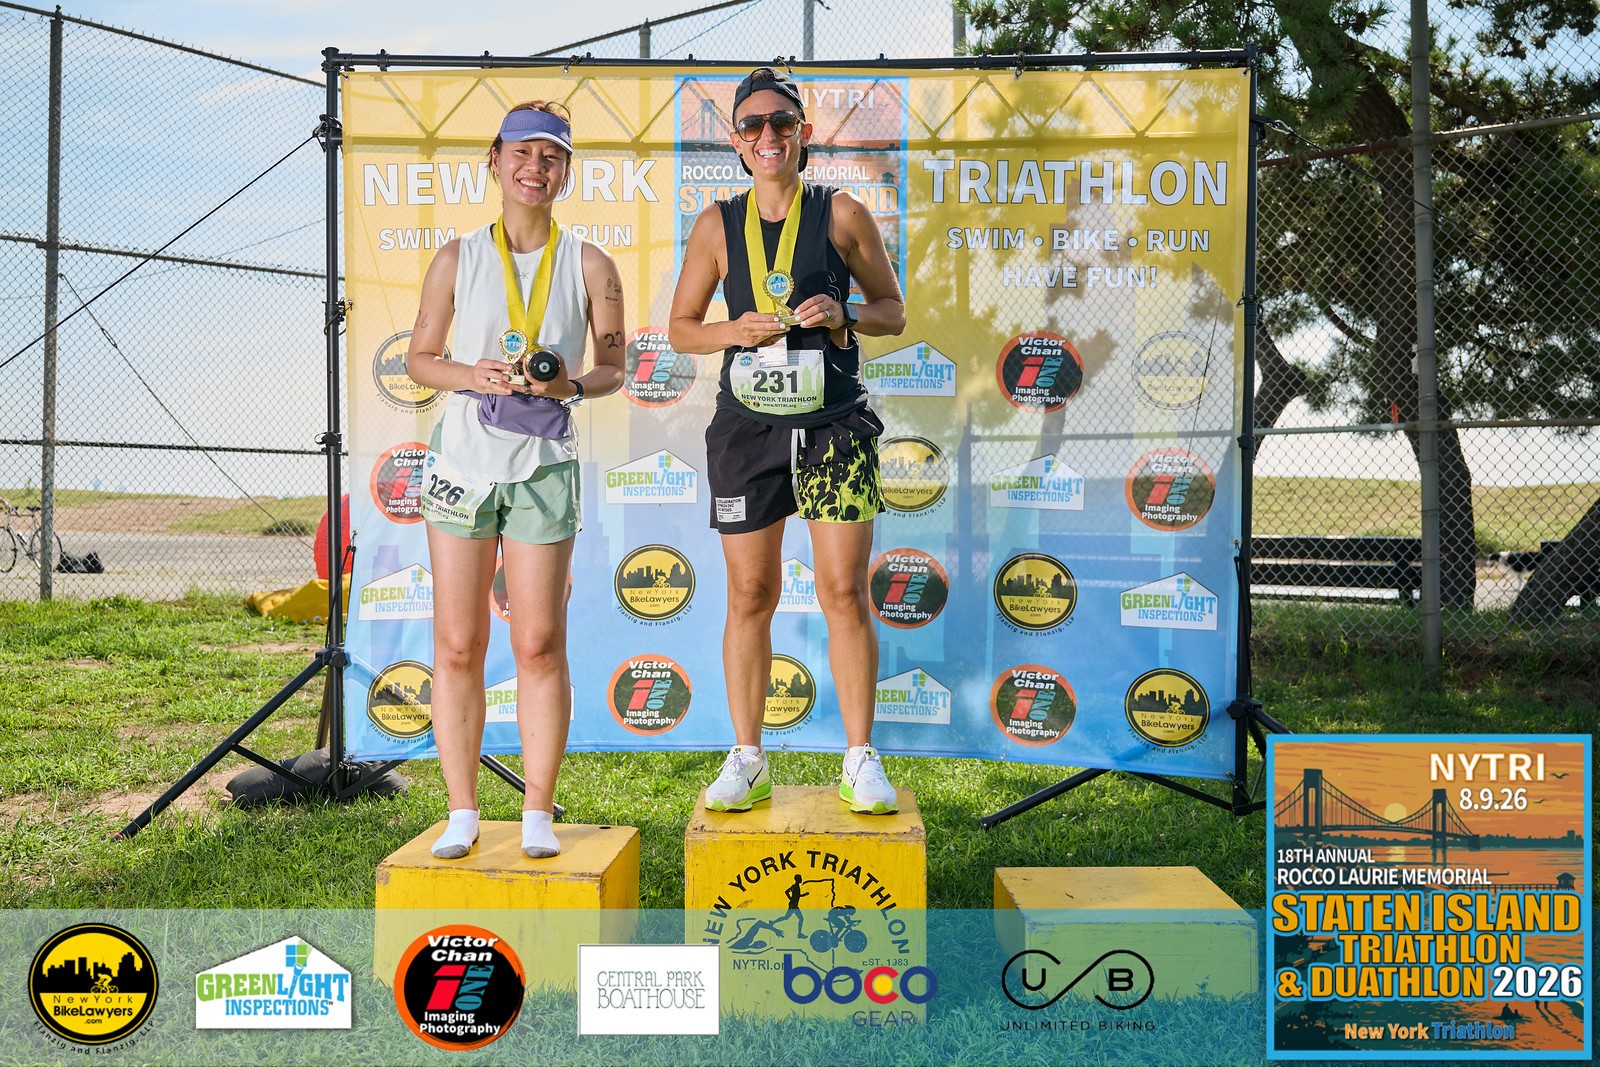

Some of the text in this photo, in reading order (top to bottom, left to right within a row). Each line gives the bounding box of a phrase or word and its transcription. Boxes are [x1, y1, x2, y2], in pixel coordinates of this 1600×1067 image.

[682, 165, 734, 182] ROCCO
[363, 161, 488, 206] NEW
[553, 160, 660, 202] RK
[923, 159, 1228, 206] TRIATHLON
[379, 224, 632, 250] SWIM RUN
[946, 227, 1210, 252] SWIM BIKE RUN
[1003, 265, 1158, 289] HAVE FUN!
[633, 332, 669, 341] Victo
[1018, 337, 1066, 347] Victor
[1020, 346, 1062, 356] Chan
[631, 381, 665, 391] Imaging
[752, 369, 798, 394] 231
[628, 389, 682, 398] Photography
[1015, 386, 1050, 396] Imaging
[1012, 394, 1067, 404] Photography
[1149, 454, 1198, 464] Victor
[1151, 463, 1194, 473] Chan
[606, 469, 696, 489] GREENLIGHT
[428, 474, 465, 507] 226
[388, 497, 418, 507] Imaging
[1144, 504, 1180, 514] Imaging
[1141, 511, 1198, 522] Photography
[886, 554, 932, 564] Victor
[888, 563, 928, 573] Chan
[361, 585, 433, 604] GREENLIGH
[630, 595, 680, 604] BikeLawyers
[882, 602, 916, 612] Imaging
[1121, 592, 1216, 614] GREENLIGHT
[1009, 604, 1061, 614] BikeLawyers
[879, 610, 933, 620] Photography
[628, 660, 675, 670] Victor
[631, 669, 672, 679] Chan
[1011, 669, 1059, 681] Victor
[1013, 679, 1056, 690] Chan
[381, 713, 430, 722] BikeLawyers
[626, 709, 660, 719] Imaging
[623, 717, 676, 727] Photography
[1009, 718, 1043, 729] Imaging
[1141, 720, 1195, 731] BikeLawyers
[1006, 726, 1060, 738] Photography
[728, 851, 797, 893] YORK
[806, 850, 910, 954] TRIATHLON
